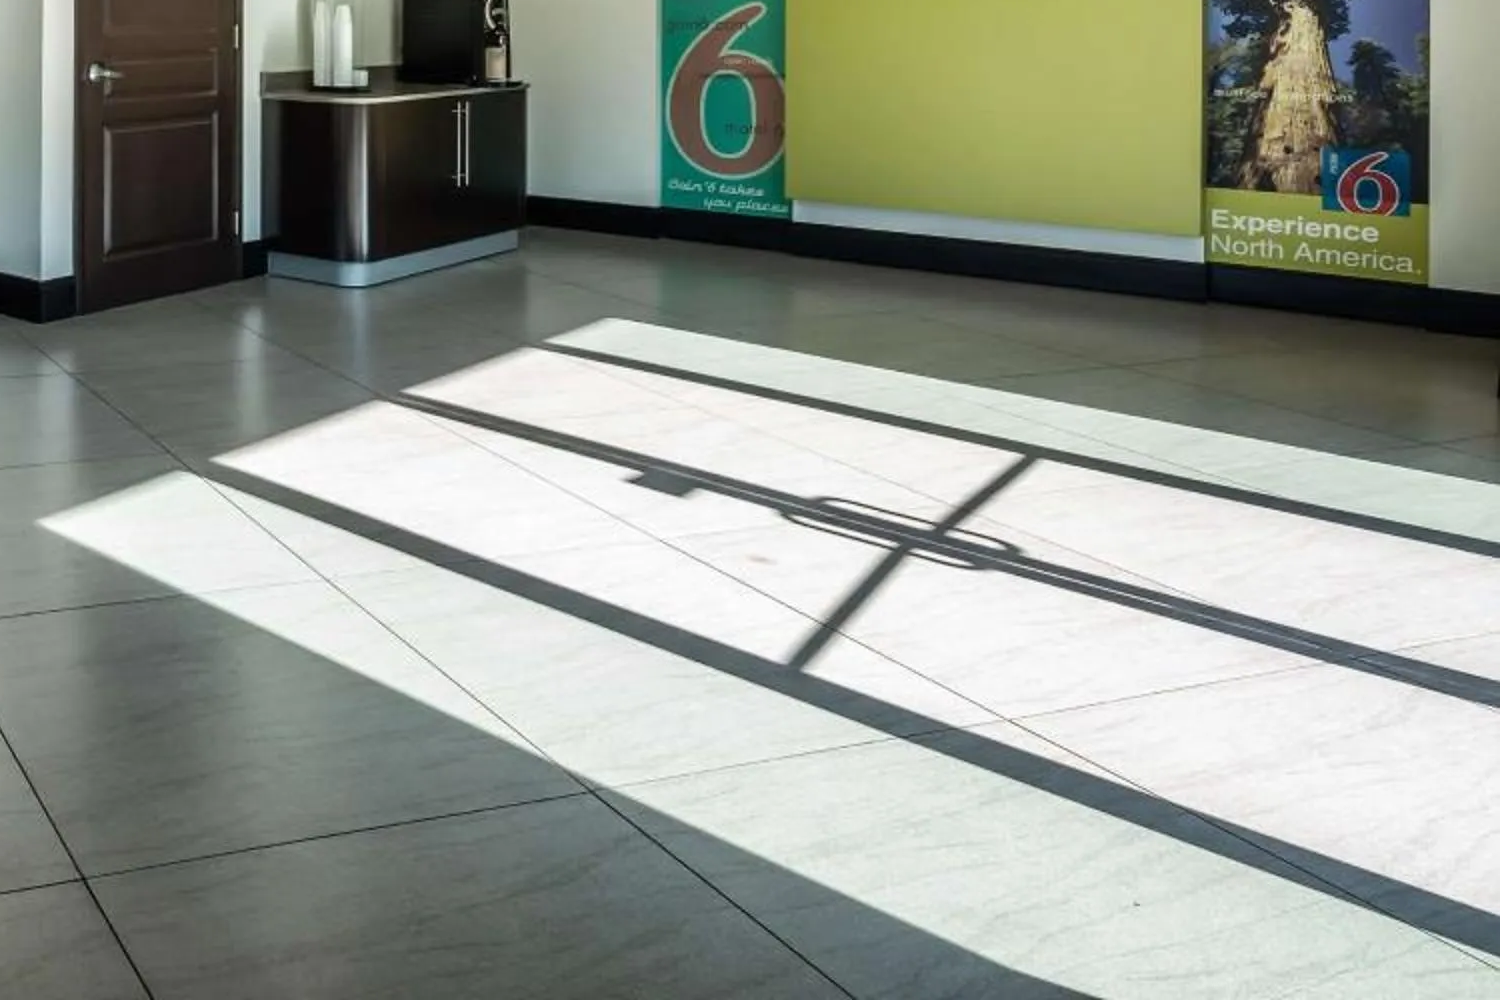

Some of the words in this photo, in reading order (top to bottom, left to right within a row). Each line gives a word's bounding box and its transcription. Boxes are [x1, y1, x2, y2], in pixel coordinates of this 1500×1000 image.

[666, 1, 786, 180] 6
[1336, 151, 1401, 217] 6
[1211, 208, 1380, 243] Experience
[1211, 233, 1284, 260] North
[1294, 242, 1422, 275] America.
